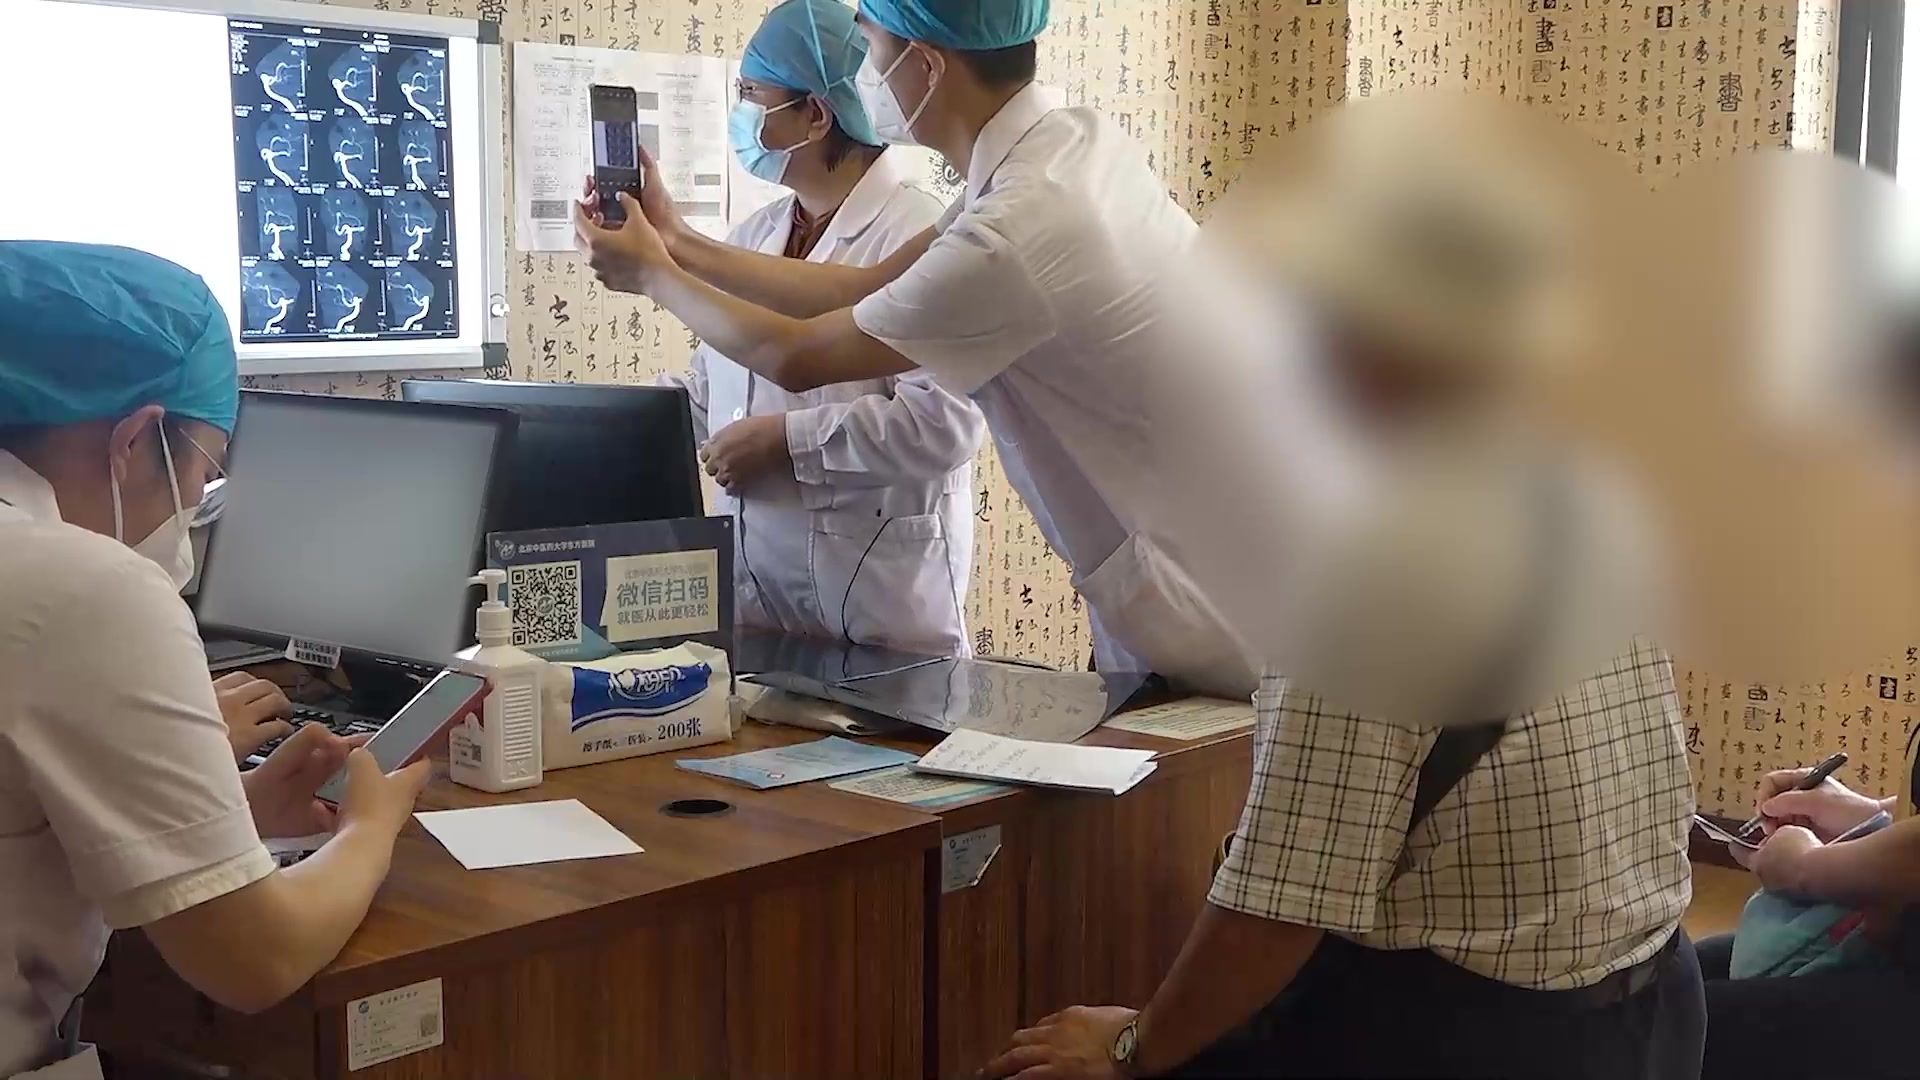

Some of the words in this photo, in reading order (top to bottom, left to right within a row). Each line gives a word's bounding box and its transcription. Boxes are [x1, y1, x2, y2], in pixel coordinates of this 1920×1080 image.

[616, 576, 709, 609] 微信扫码
[617, 604, 709, 625] 就医从此更轻松
[657, 717, 702, 741] 200张
